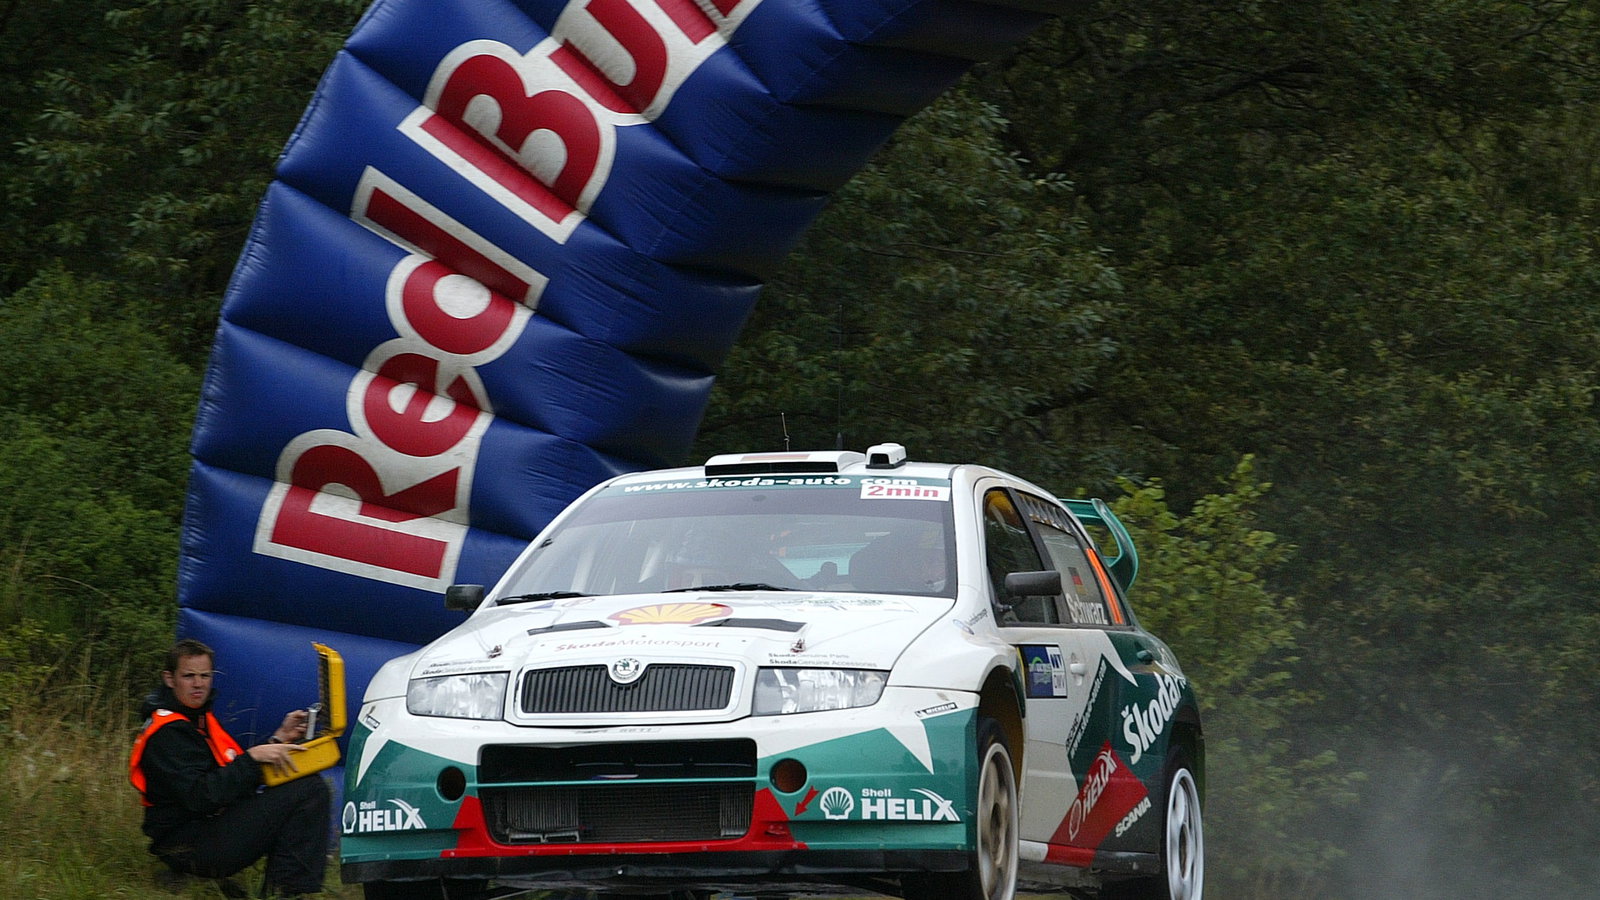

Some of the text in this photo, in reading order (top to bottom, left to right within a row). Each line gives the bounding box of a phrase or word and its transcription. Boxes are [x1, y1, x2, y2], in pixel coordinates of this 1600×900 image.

[253, 0, 760, 593] Red Bu
[623, 476, 917, 493] www.skoda-autocom
[867, 485, 939, 497] 2min
[862, 788, 892, 797] Shell
[359, 801, 376, 810] Shell
[359, 802, 427, 832] HELIX
[861, 790, 961, 821] HELIX
[1115, 796, 1152, 837] SCANIA
